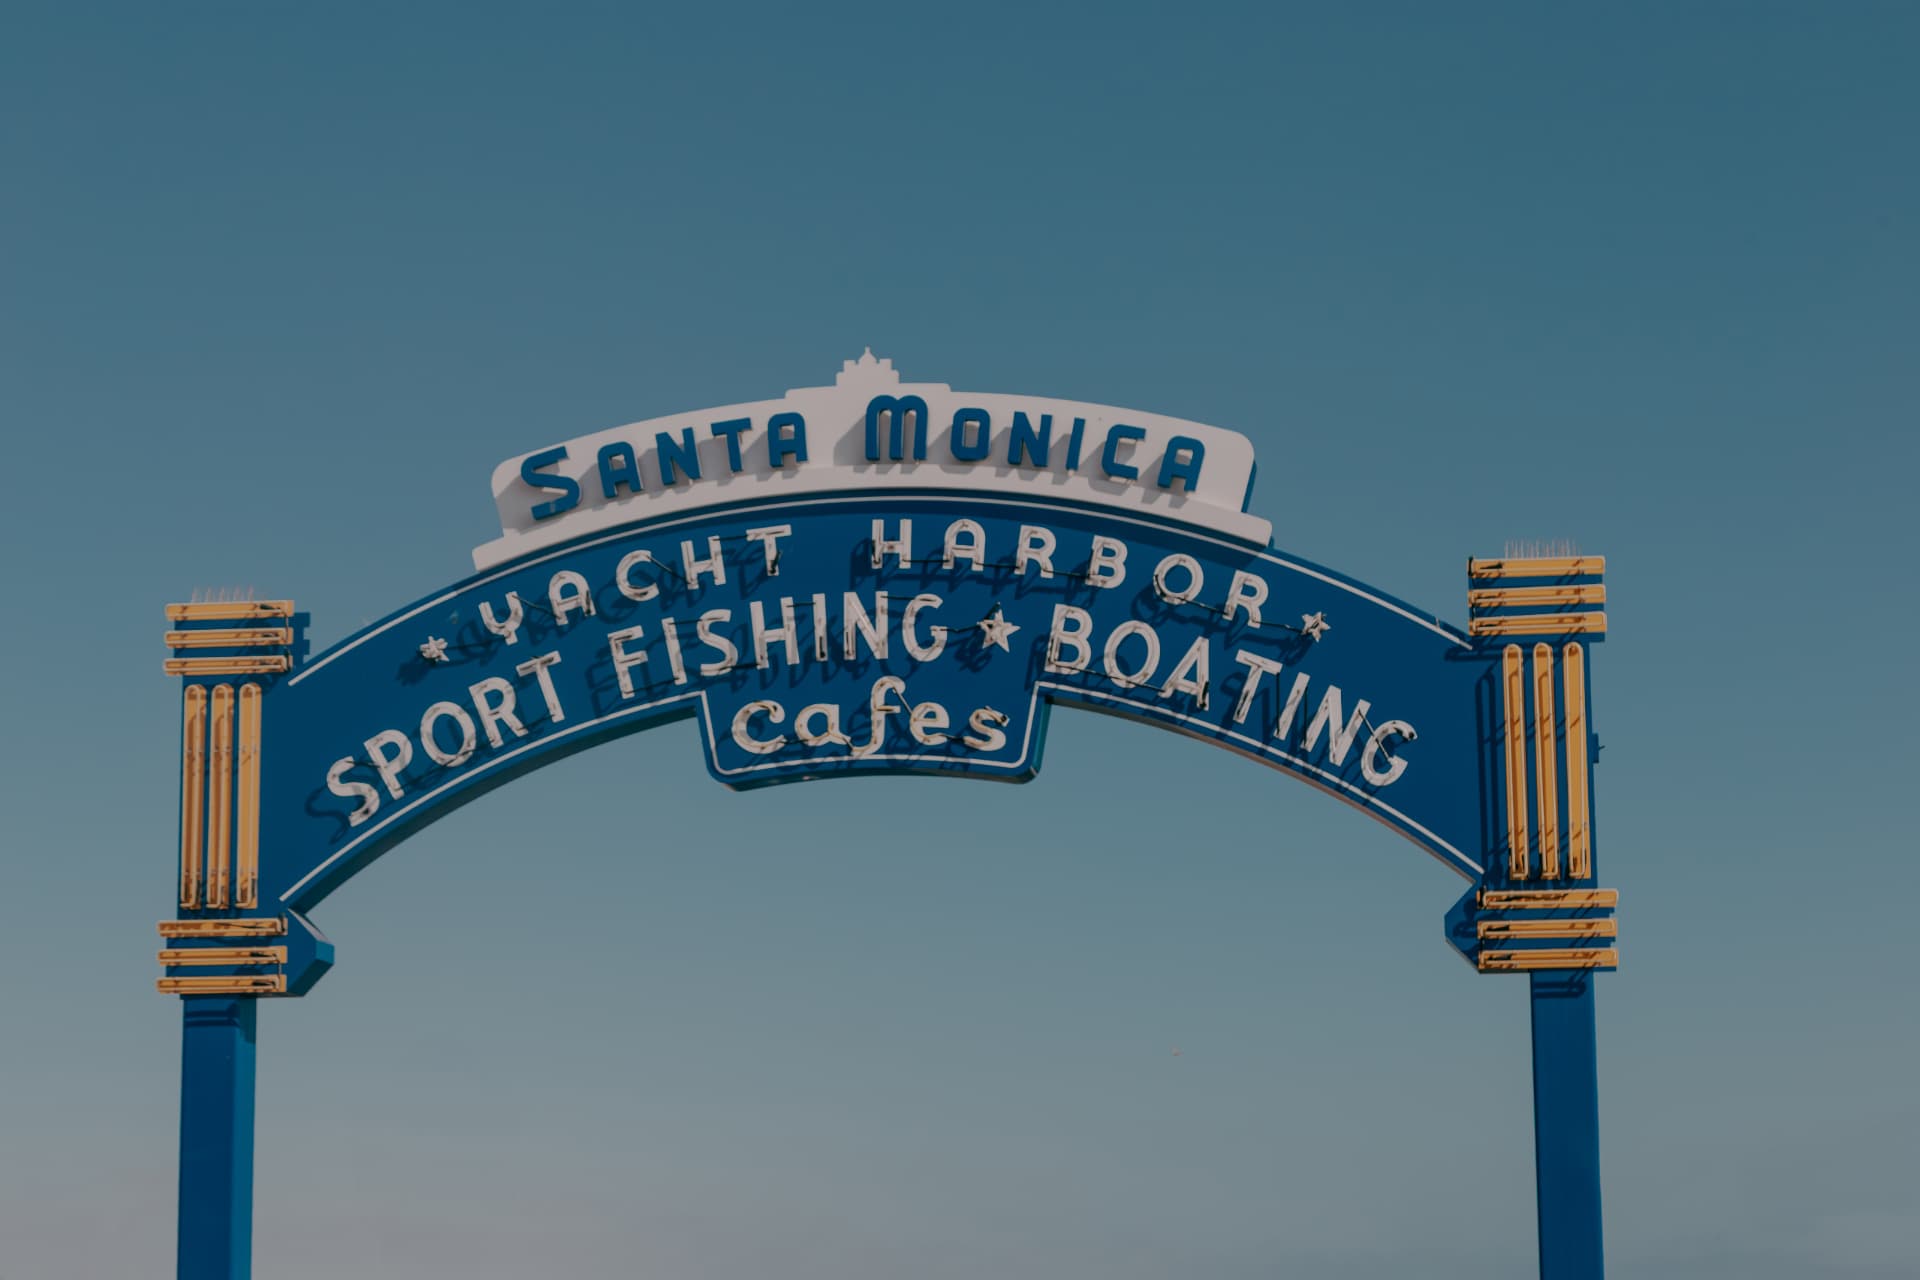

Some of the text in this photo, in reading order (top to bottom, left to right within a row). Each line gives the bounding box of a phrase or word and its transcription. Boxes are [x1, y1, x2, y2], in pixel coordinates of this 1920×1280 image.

[521, 395, 1205, 521] SANTA MONICA
[478, 519, 1269, 645] YACHT HARBOR
[326, 591, 1418, 827] SPORT FISHING BOATING
[731, 676, 1010, 755] cafes
